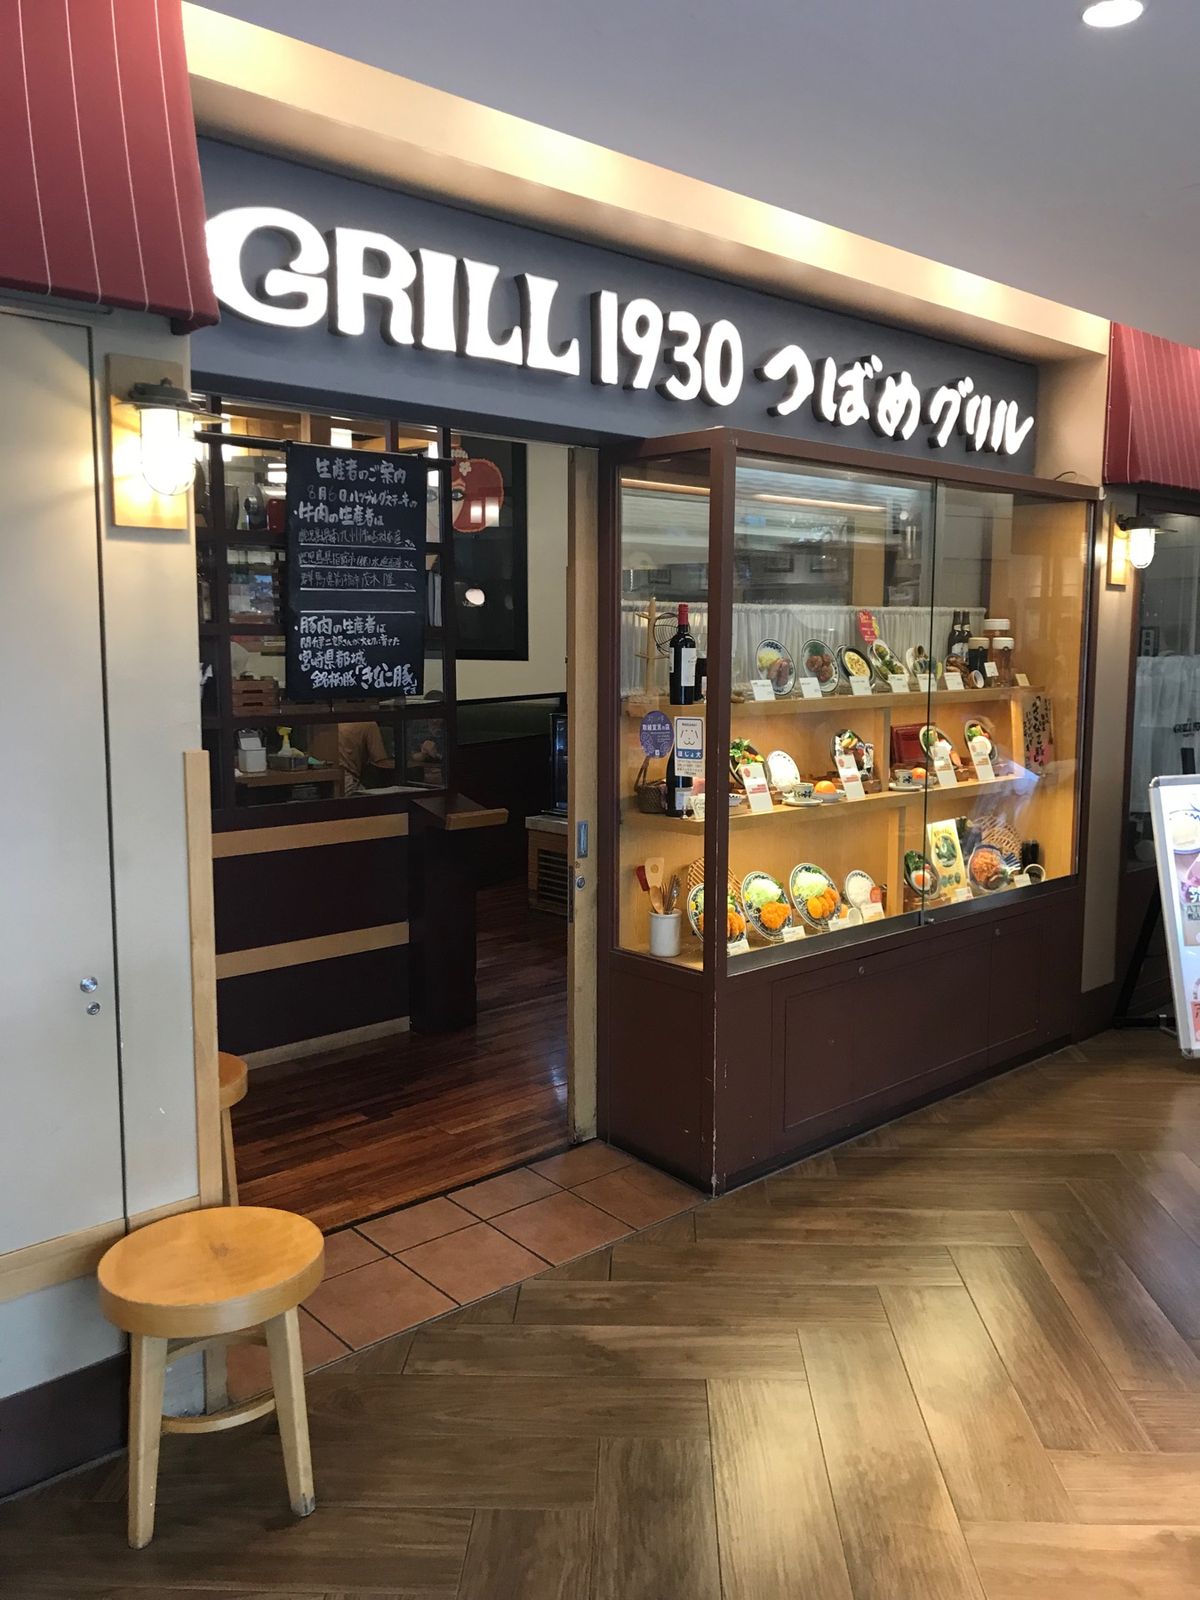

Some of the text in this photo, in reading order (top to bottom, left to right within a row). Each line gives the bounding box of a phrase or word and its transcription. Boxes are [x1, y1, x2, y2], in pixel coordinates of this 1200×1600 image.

[205, 206, 744, 406] GRILL 1930
[763, 344, 1035, 455] つばめグリル
[315, 457, 408, 484] 生産者のご案内
[298, 648, 368, 672] 宮崎県都城
